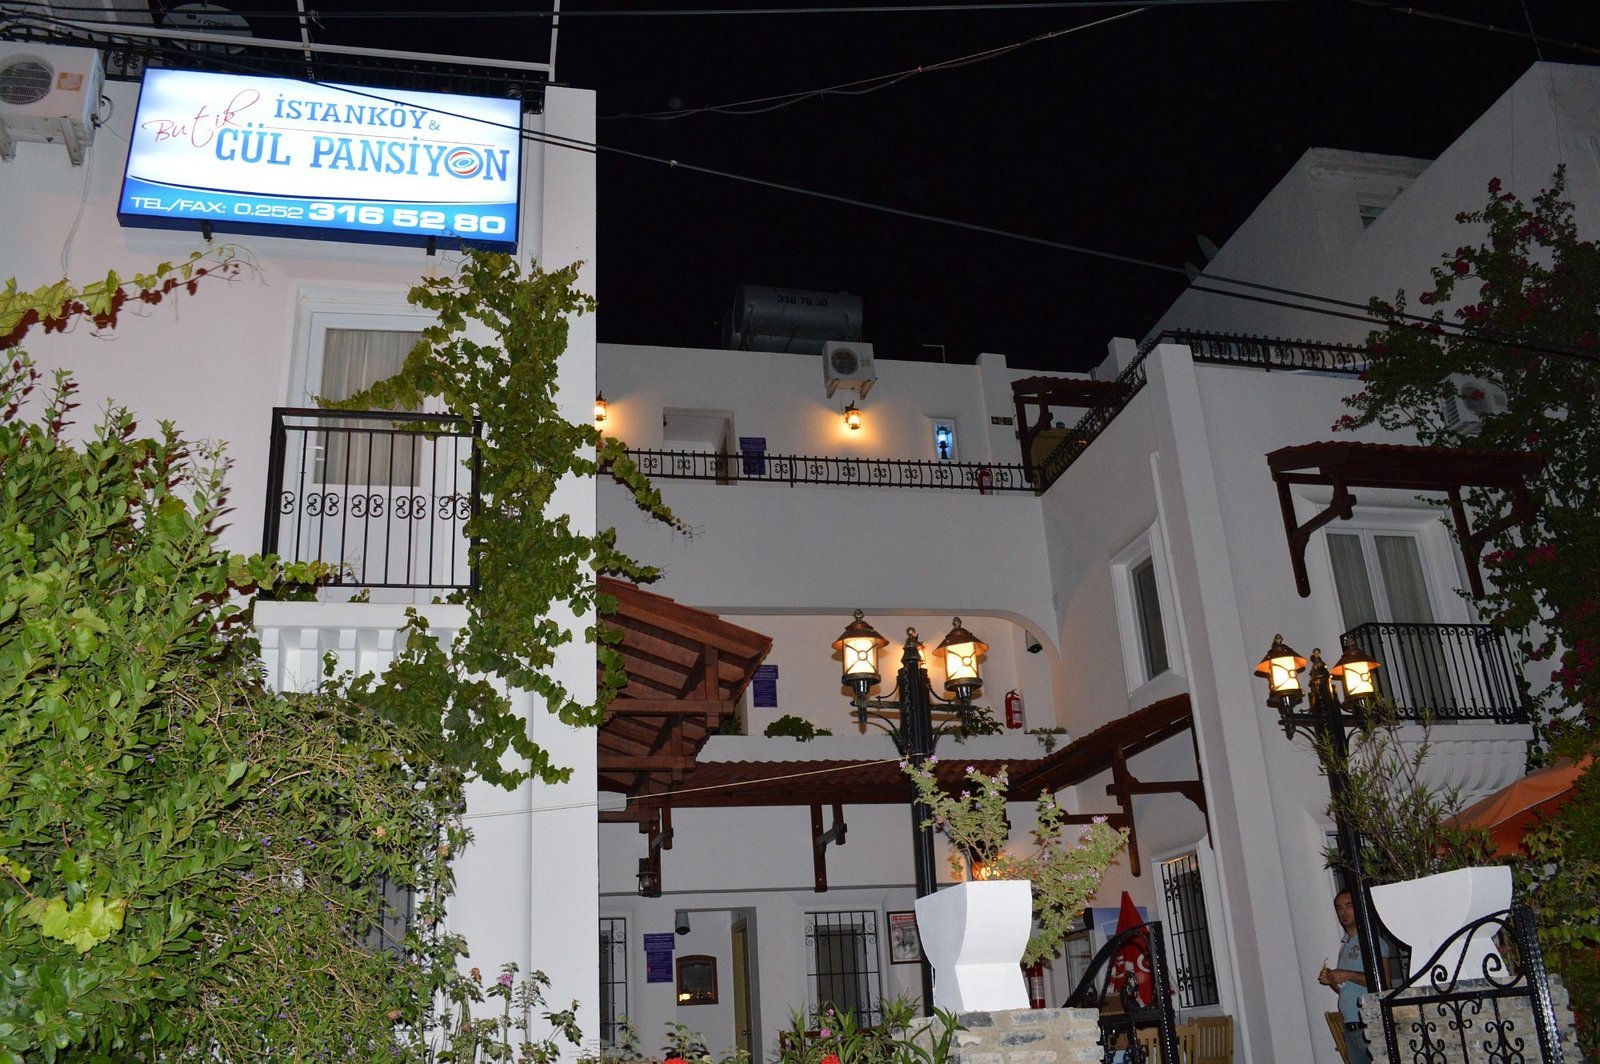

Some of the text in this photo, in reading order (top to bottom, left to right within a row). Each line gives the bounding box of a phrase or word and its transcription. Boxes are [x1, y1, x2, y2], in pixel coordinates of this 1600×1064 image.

[274, 93, 428, 129] İSTANKÖY
[215, 122, 510, 182] GÜL PANSİYON
[131, 196, 506, 234] TEL/FAX: 0.252 316 52 80
